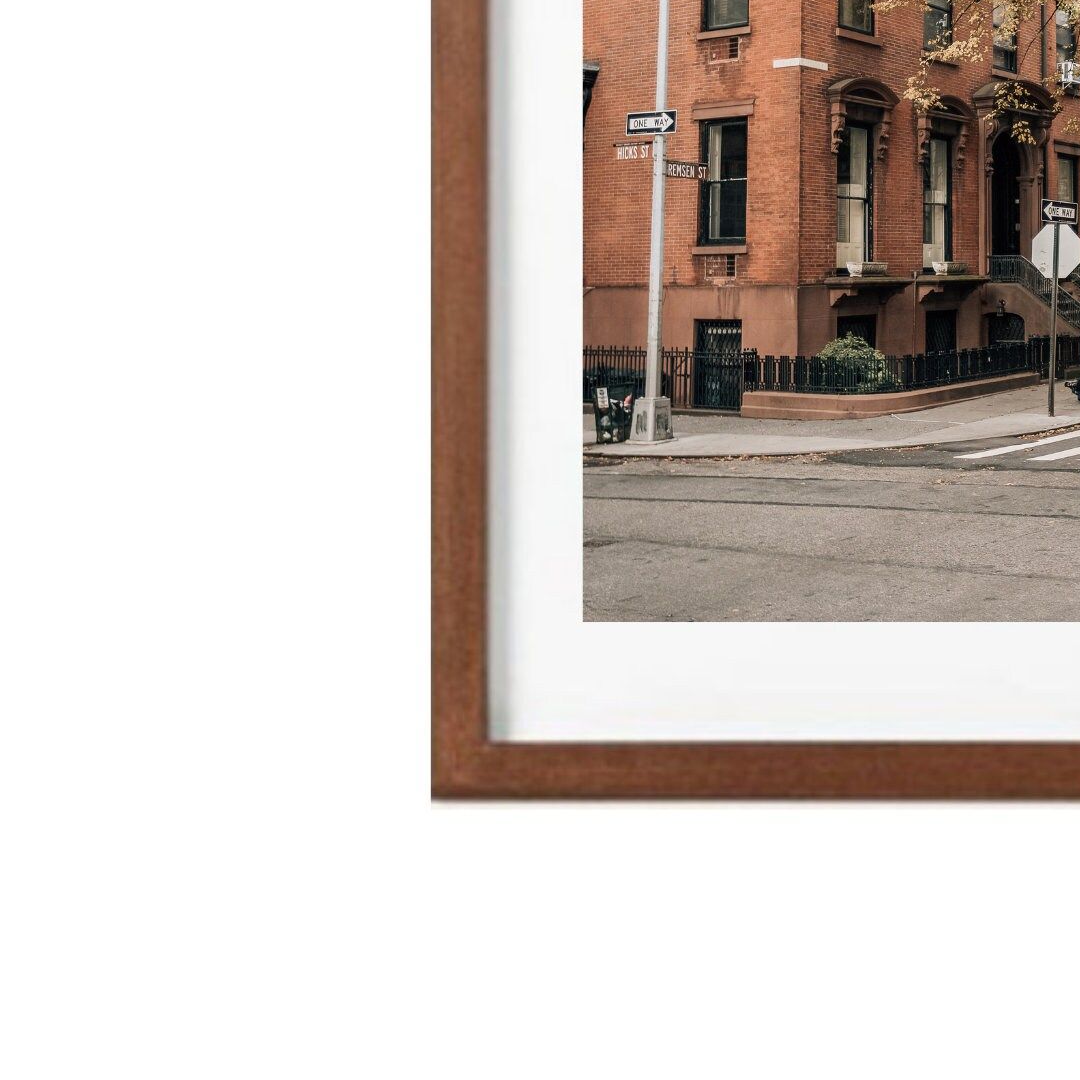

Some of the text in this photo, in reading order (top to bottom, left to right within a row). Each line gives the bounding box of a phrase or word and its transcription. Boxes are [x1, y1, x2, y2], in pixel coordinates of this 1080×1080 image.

[633, 118, 669, 128] ONE WAY
[617, 145, 650, 160] HICKS ST
[668, 163, 707, 179] REMSEN ST
[1048, 207, 1073, 217] ONE WAY
